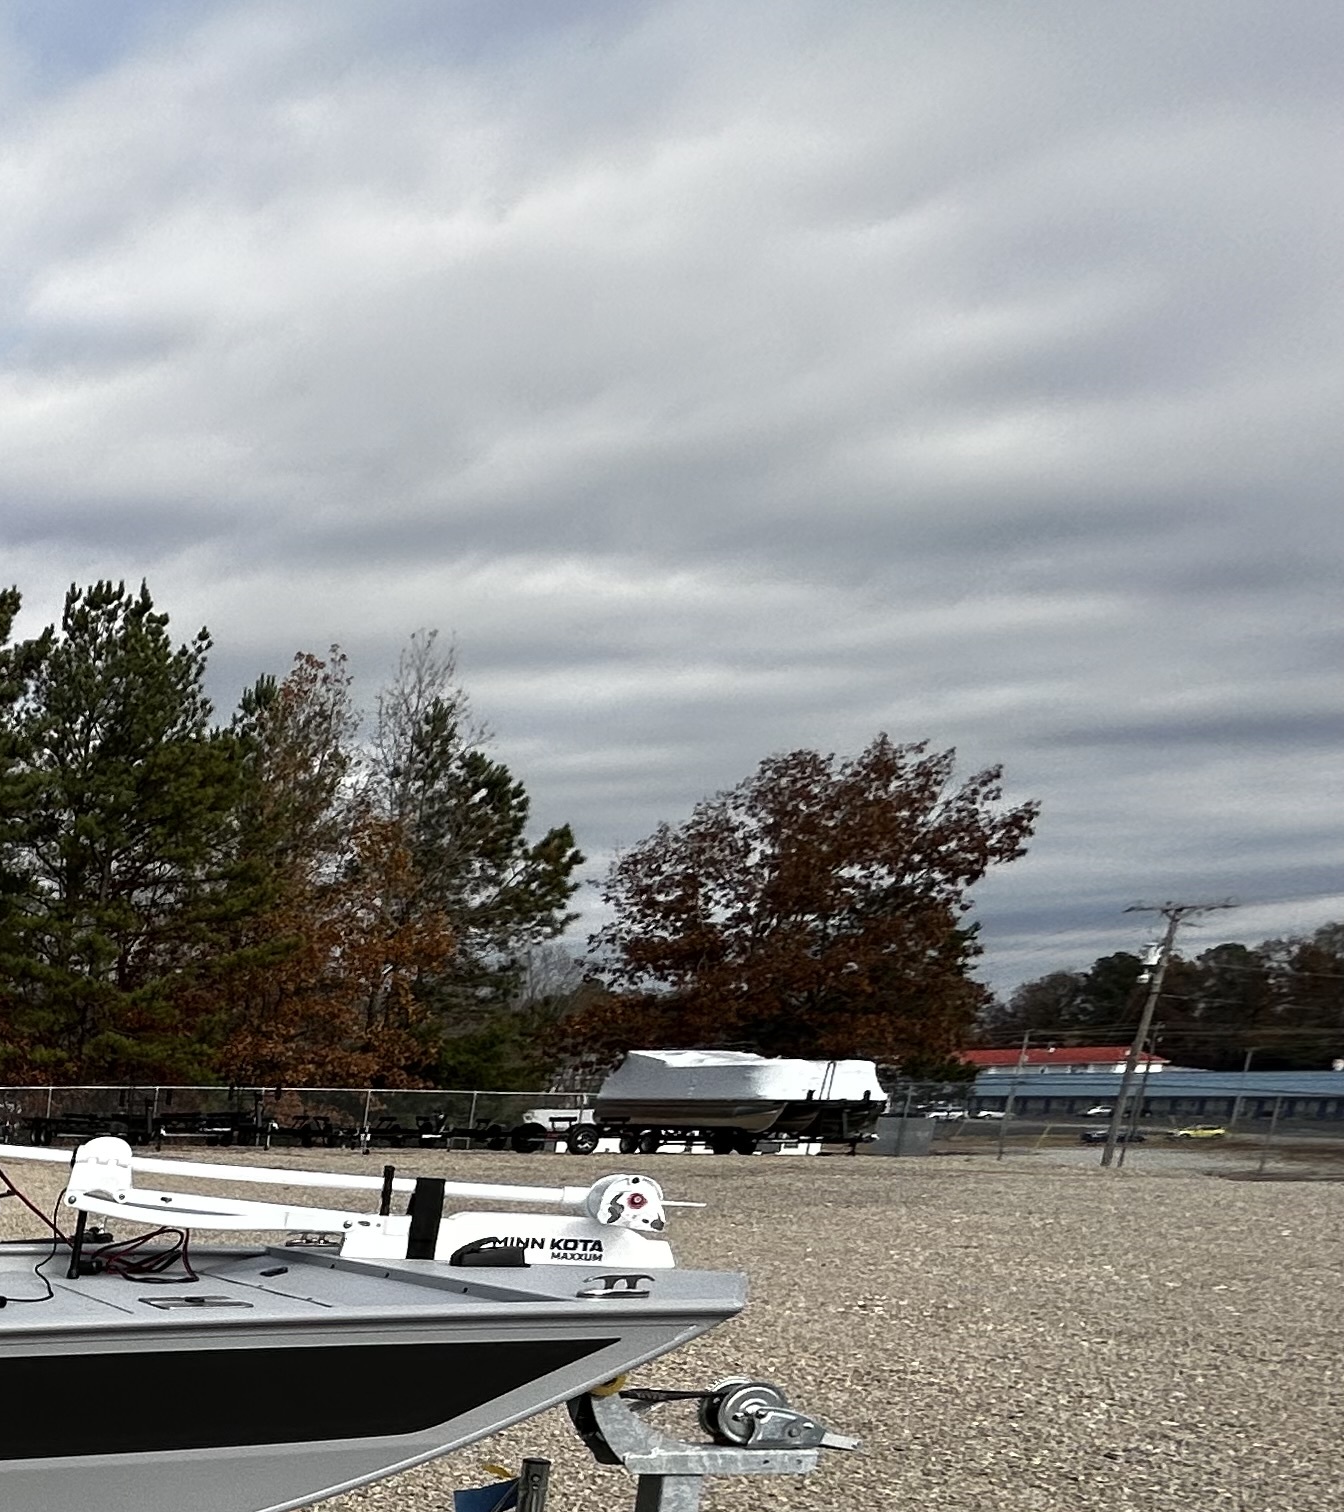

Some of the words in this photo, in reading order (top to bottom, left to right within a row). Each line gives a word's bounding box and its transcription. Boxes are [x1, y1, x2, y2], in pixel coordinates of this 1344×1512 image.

[493, 1237, 545, 1249] MINN
[551, 1238, 603, 1252] KOTA
[551, 1252, 603, 1261] MAXXUM
